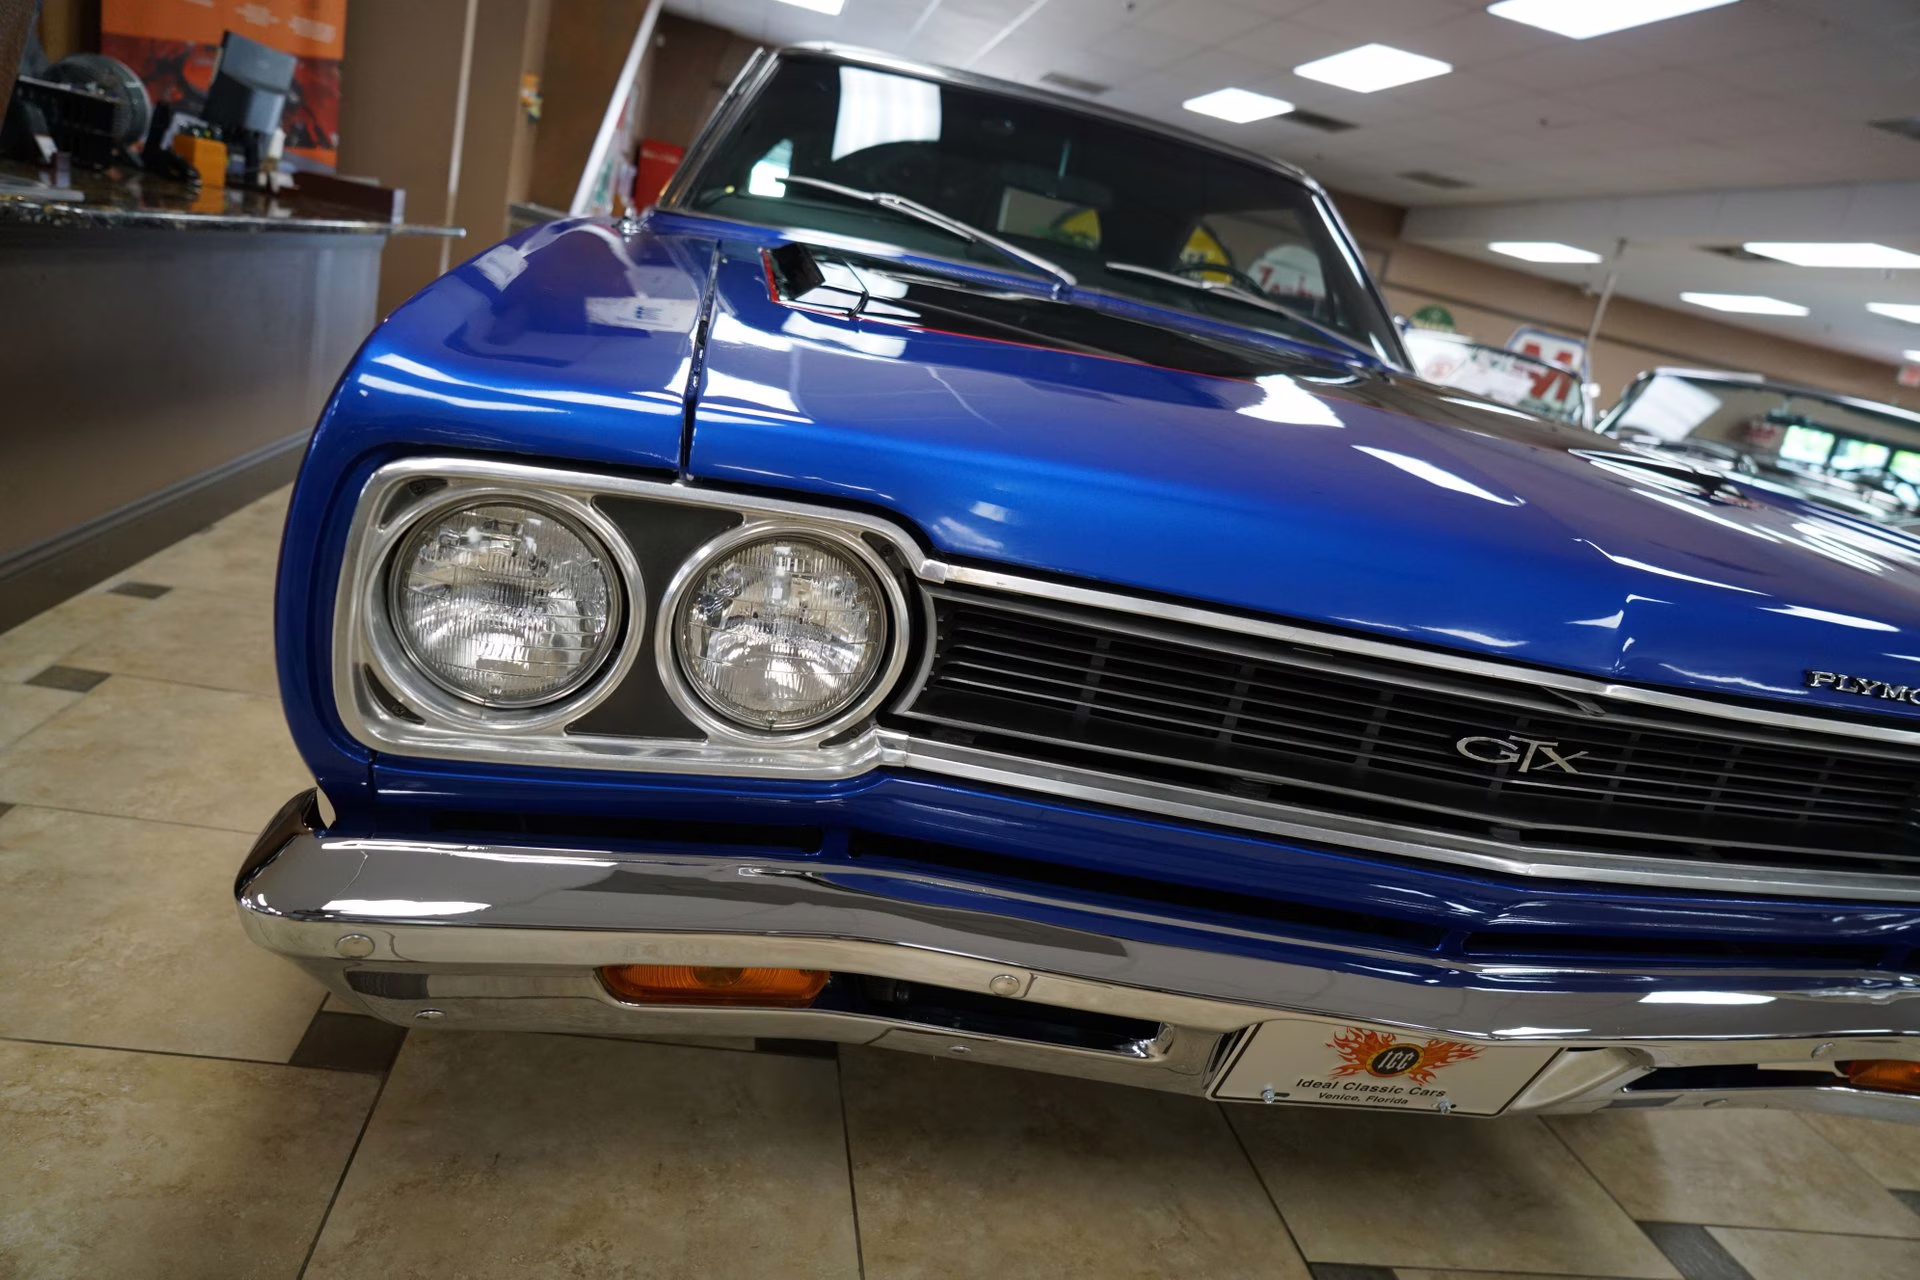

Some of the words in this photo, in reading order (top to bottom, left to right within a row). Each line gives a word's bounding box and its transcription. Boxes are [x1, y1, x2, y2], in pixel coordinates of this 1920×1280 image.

[1456, 734, 1589, 774] GTX
[1296, 1078, 1339, 1090] Ideal
[1343, 1082, 1404, 1095] Classic
[1408, 1086, 1447, 1098] Cars
[1318, 1092, 1361, 1103] Venice,
[1365, 1095, 1409, 1105] Florida
